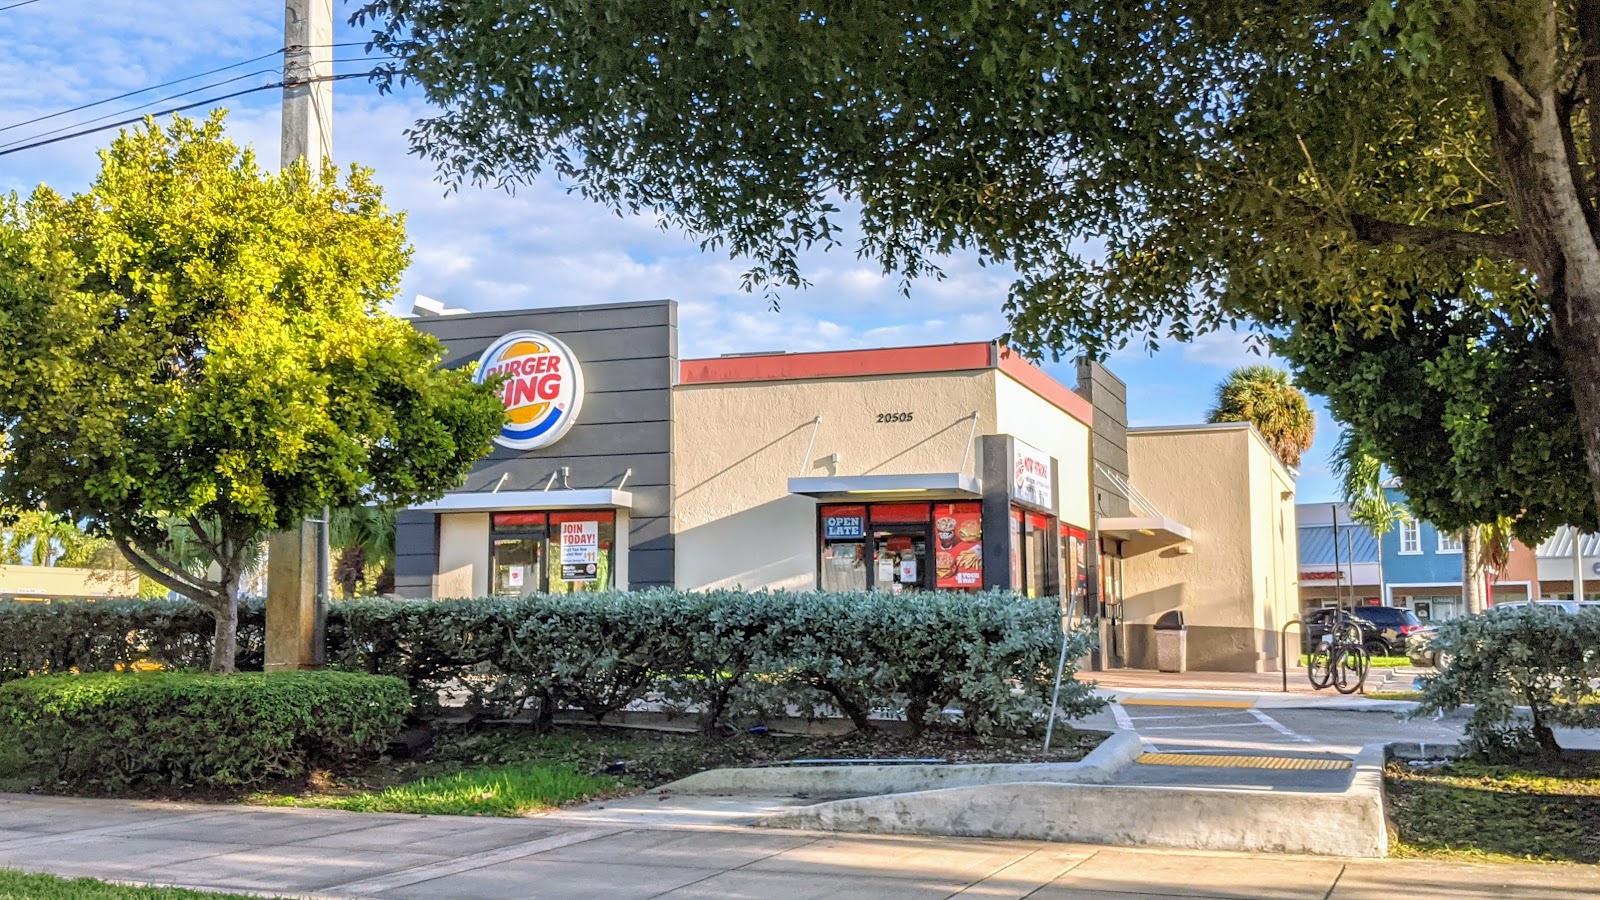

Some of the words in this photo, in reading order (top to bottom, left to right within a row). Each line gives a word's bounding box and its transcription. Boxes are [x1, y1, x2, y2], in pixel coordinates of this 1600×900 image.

[495, 374, 562, 407] ING
[876, 412, 913, 423] 20505
[828, 517, 859, 526] OPEN
[563, 524, 582, 533] JOIN
[829, 526, 859, 535] LATE
[563, 534, 595, 544] TODAY!
